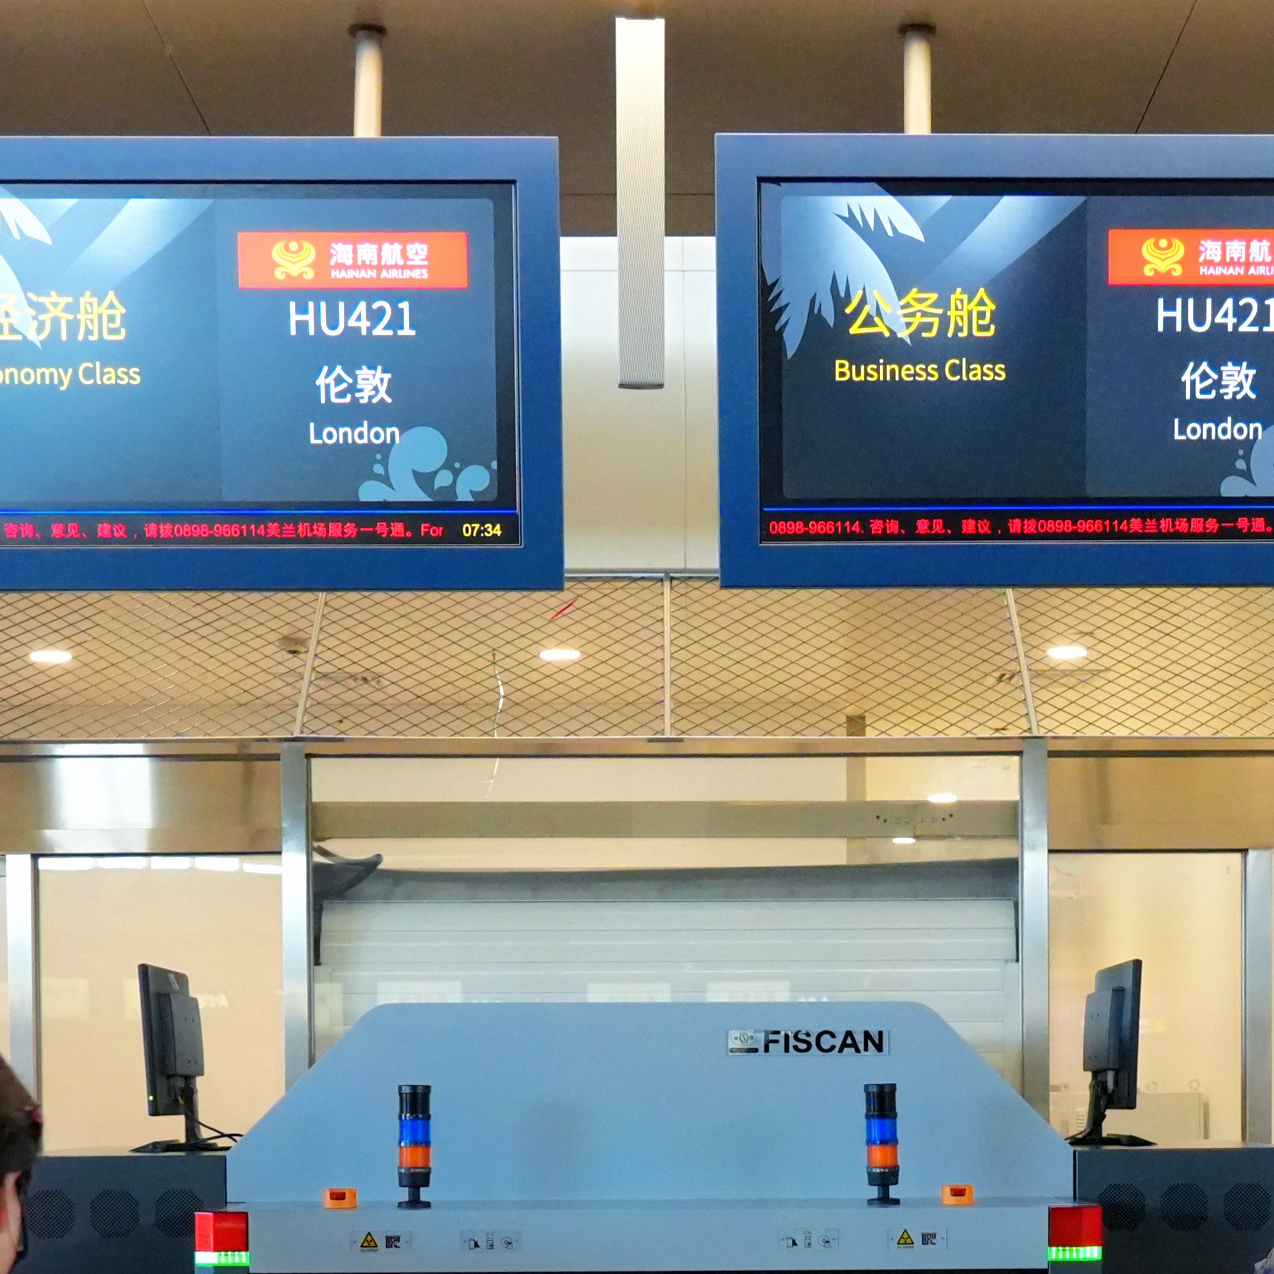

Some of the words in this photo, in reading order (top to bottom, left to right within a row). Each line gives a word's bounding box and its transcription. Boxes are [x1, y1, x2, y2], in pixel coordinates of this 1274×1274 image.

[329, 242, 429, 266] 海南航空
[331, 269, 377, 279] HAINAN
[380, 269, 428, 279] AIRLINES
[1200, 266, 1244, 276] HAINAN
[289, 300, 416, 336] HU421
[844, 287, 996, 338] 公务舱
[78, 361, 141, 385] Class
[834, 358, 939, 381] Business
[945, 357, 1006, 381] Class
[1181, 361, 1257, 400] 伦敦
[315, 365, 393, 404] 伦敦
[309, 420, 400, 444] London
[1173, 416, 1263, 440] London
[420, 523, 444, 537] For
[462, 523, 502, 537] 07:34
[763, 1030, 884, 1053] FISCAN
